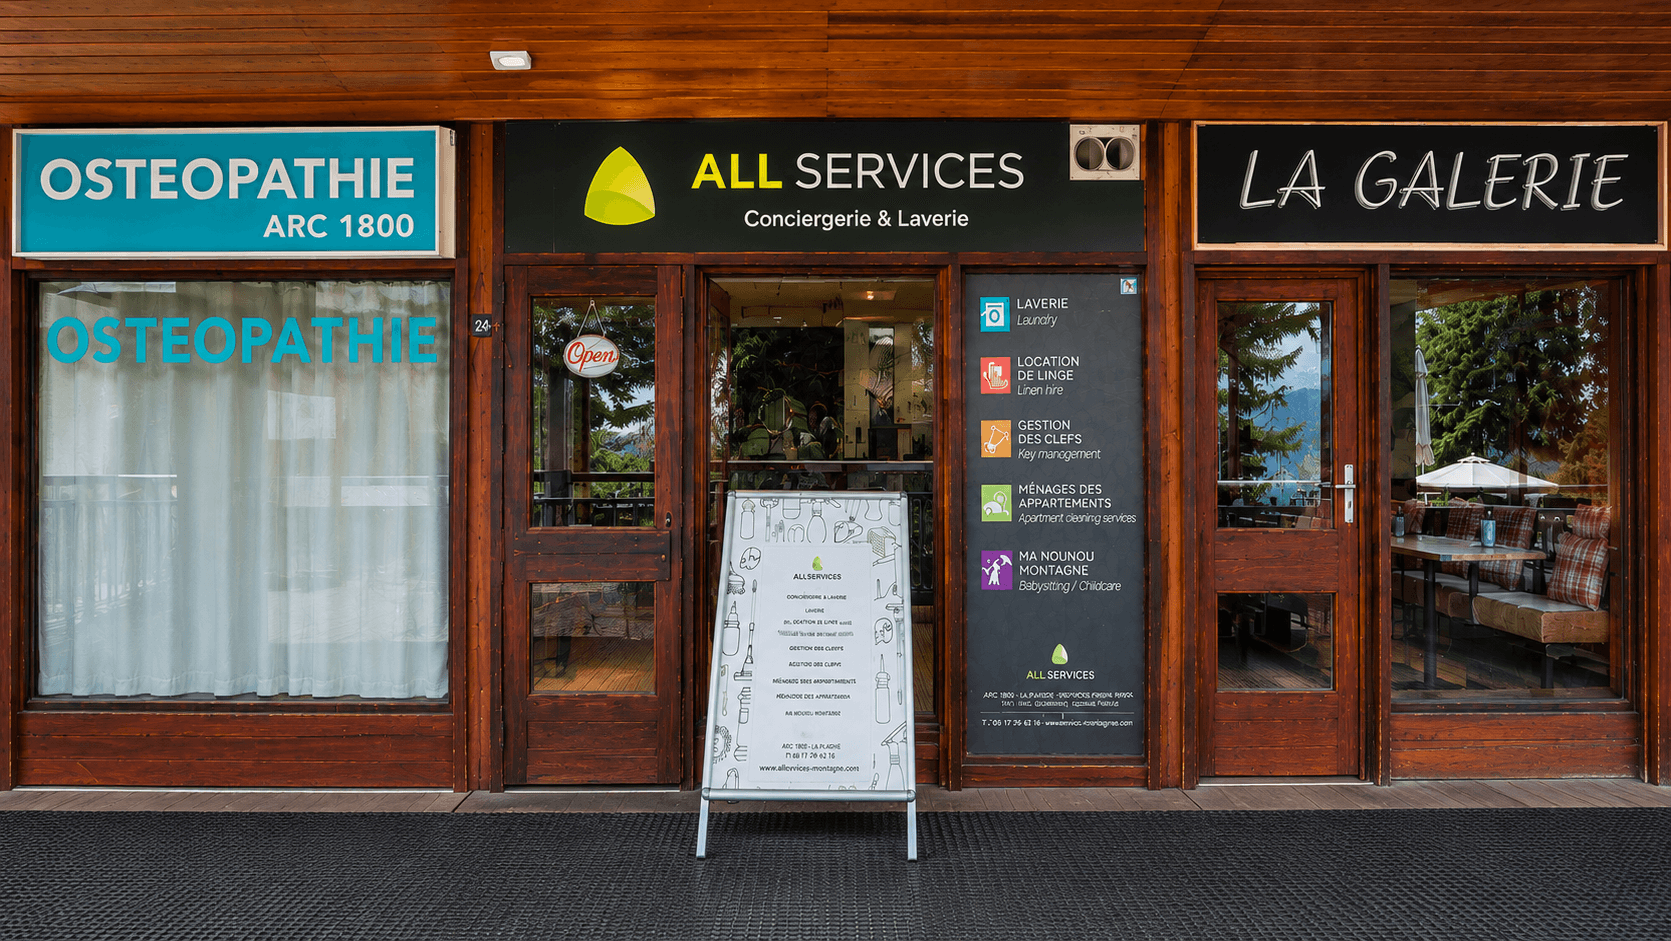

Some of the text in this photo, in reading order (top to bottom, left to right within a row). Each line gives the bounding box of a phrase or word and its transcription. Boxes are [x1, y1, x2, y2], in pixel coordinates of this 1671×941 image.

[691, 152, 1026, 190] ALL SERVICES
[40, 158, 415, 200] OSTEOPATHIE
[1239, 149, 1629, 211] LA GALERIE
[263, 213, 415, 238] ARC 1800
[744, 209, 969, 231] Conciergerie & Laverie
[1017, 298, 1069, 309] LAVERIE
[1017, 314, 1058, 328] Laundry
[47, 316, 438, 364] OSTEOPATHIE
[567, 341, 619, 373] Open
[1017, 356, 1080, 367] LOCATION
[1017, 370, 1074, 381] DE LINGE
[1017, 385, 1064, 396] Linen hire
[1018, 420, 1071, 431] GESTION
[1018, 434, 1083, 445] DES CLEFS
[1018, 449, 1101, 462] Key management
[1018, 482, 1102, 495] MÉNAGES DES
[1018, 498, 1112, 509] APPARTEMENTS
[1018, 513, 1064, 525] Apartment
[1102, 513, 1137, 524] services
[1019, 551, 1095, 562] MA NOUNOU
[1019, 565, 1089, 576] MONTAGNE
[1018, 580, 1122, 594] Babysitting / Childcare
[1026, 670, 1095, 680] ALL SERVICES
